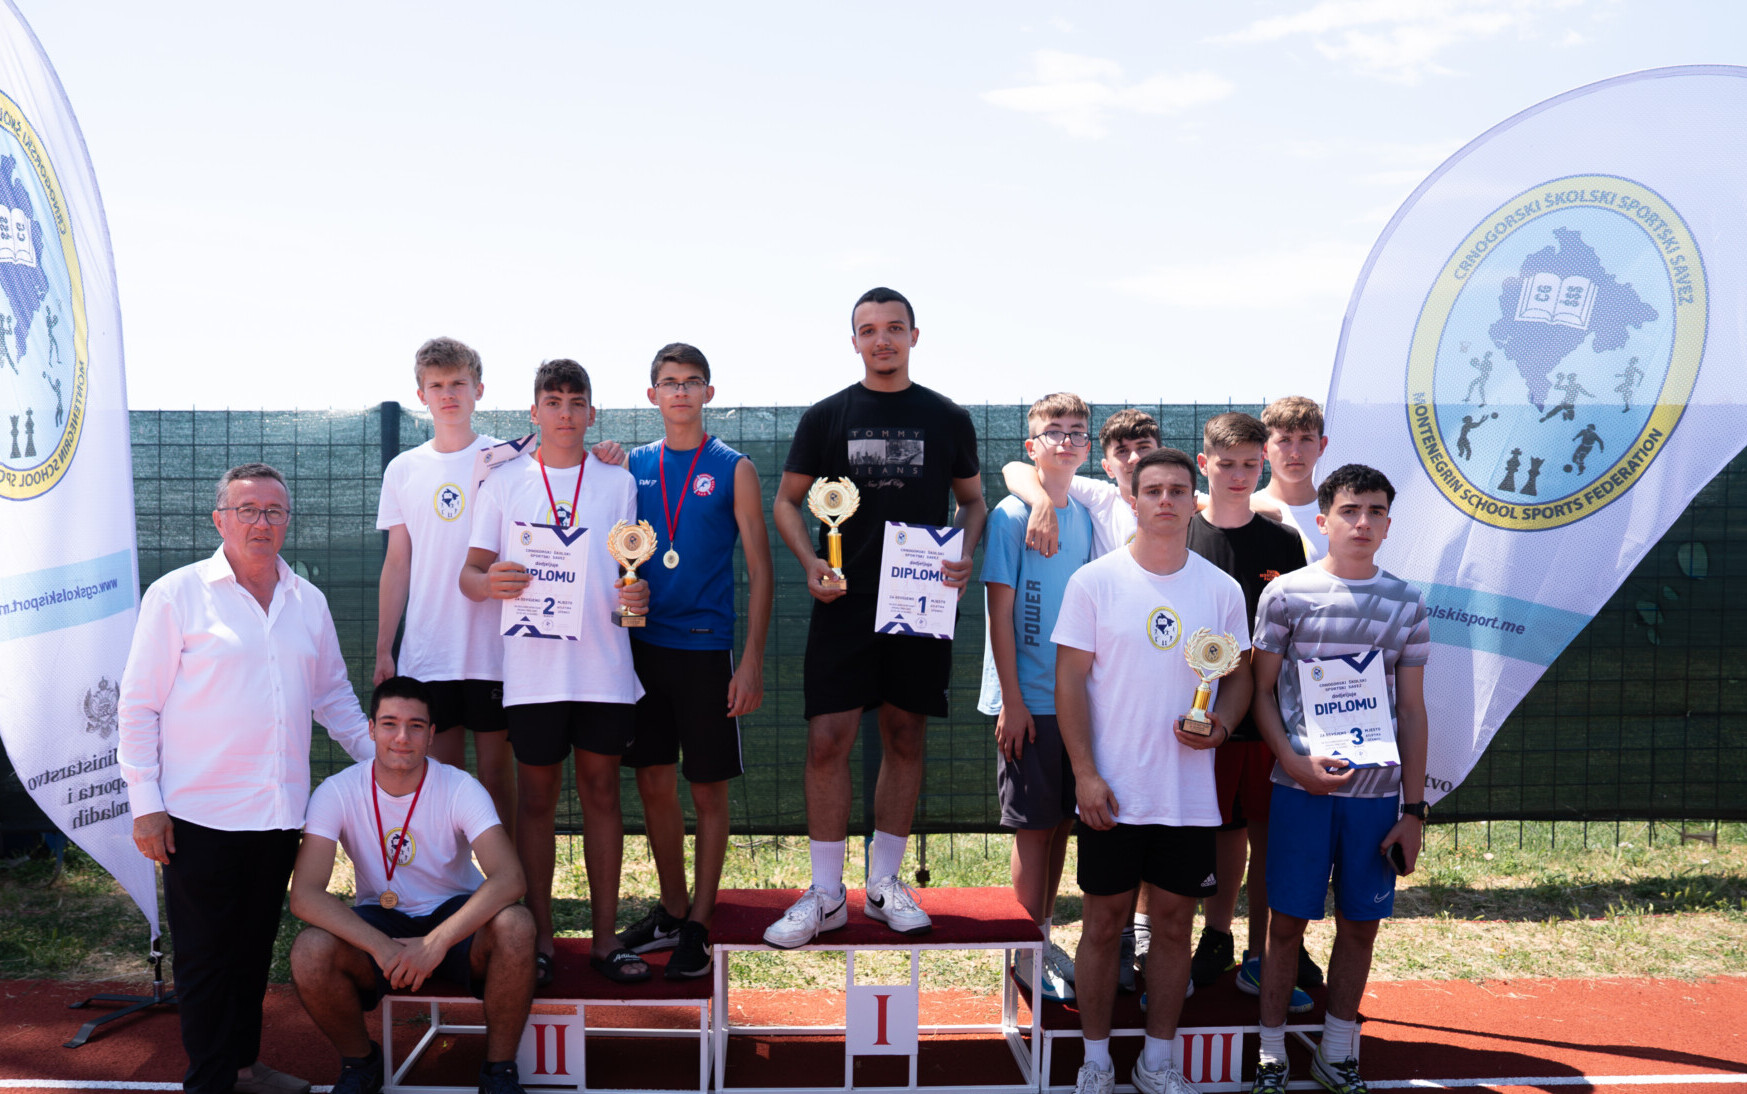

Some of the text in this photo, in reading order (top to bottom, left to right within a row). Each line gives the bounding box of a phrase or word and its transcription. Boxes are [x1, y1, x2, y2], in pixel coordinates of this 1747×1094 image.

[1454, 190, 1694, 306] CRNOGORSKI ŠKOLSKI SPORTSKI SAVEZ
[851, 430, 920, 438] TOMMY
[854, 466, 918, 476] JEANS
[1412, 392, 1664, 521] MONTENEGRIN SCHOOL SPORTS FEDERATION
[542, 596, 555, 615] 2
[918, 596, 927, 614] 1
[1024, 579, 1041, 647] POWER
[1314, 696, 1377, 716] DIPLOMU
[1350, 727, 1364, 745] 3
[874, 994, 892, 1046] I
[530, 1024, 571, 1076] II
[1180, 1032, 1238, 1084] III
